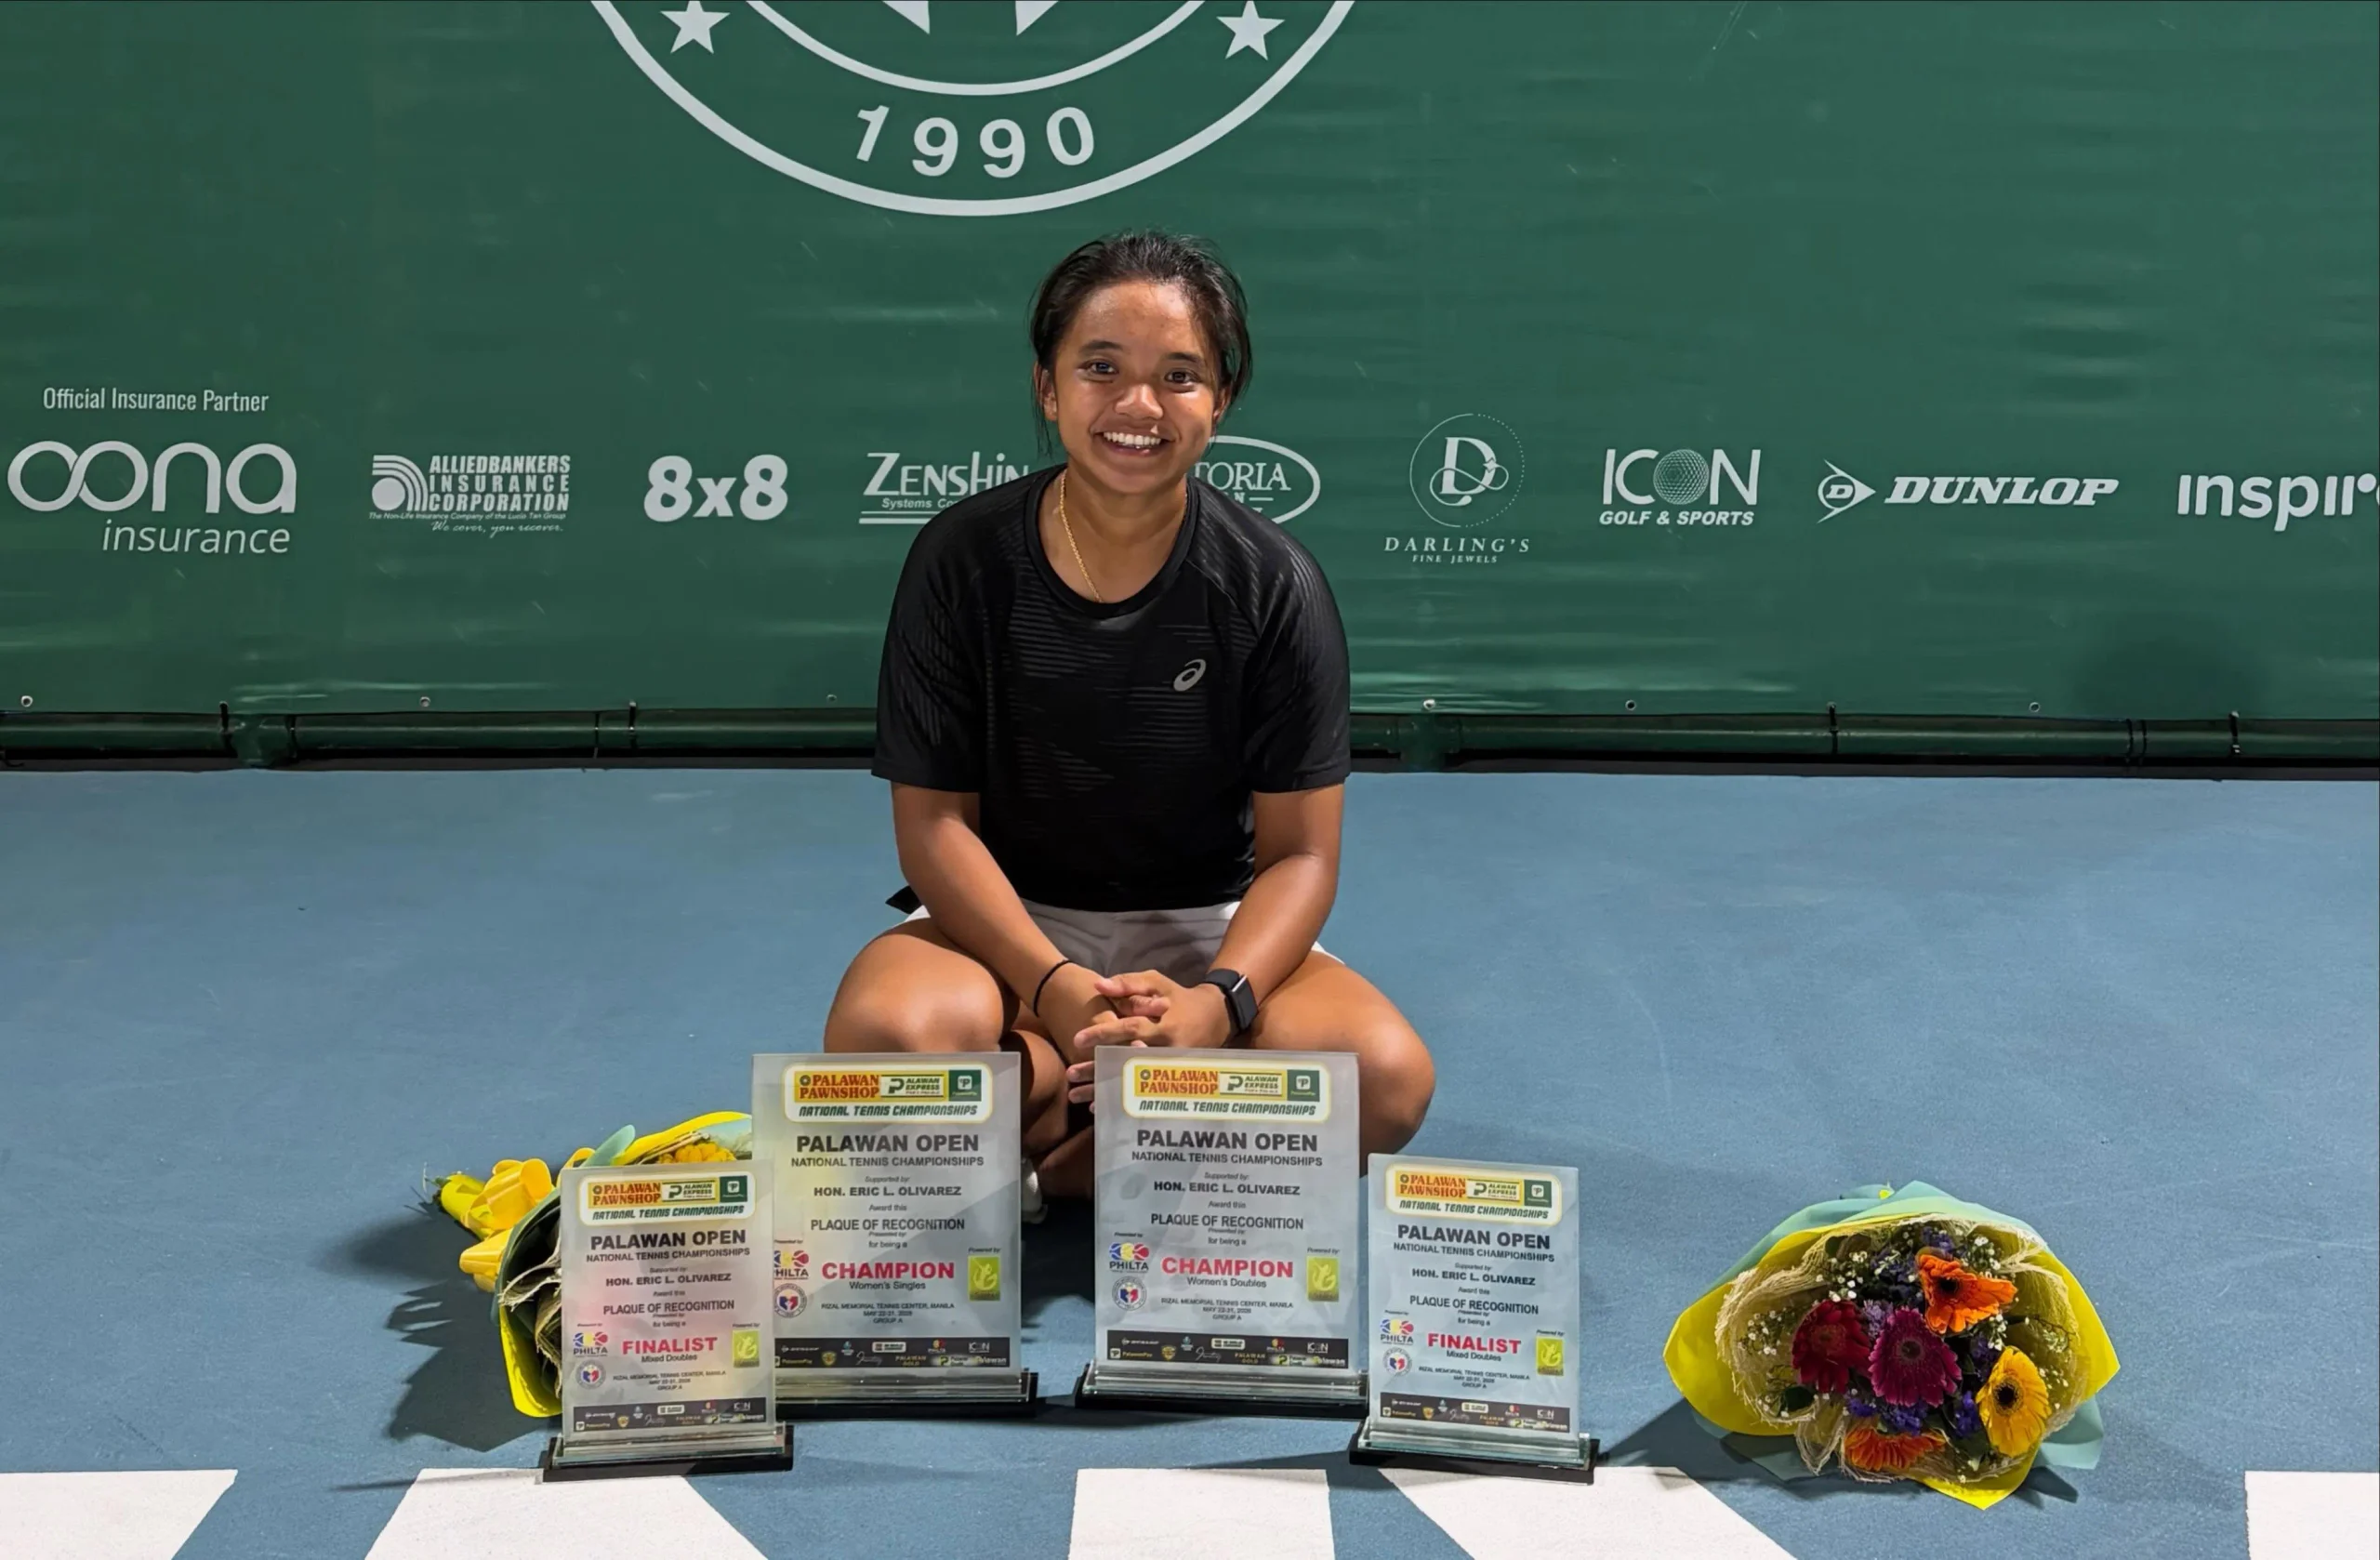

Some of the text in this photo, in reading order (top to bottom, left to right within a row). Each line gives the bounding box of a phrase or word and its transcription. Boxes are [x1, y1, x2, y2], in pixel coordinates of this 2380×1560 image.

[855, 104, 1095, 178] 1990
[44, 388, 270, 412] Official Insurance Partner
[429, 455, 571, 473] ALLIEDBANKERS
[7, 441, 298, 514] oona
[430, 474, 570, 493] INSURANCE
[1194, 462, 1291, 491] TORIA
[643, 455, 788, 522] 8x8
[1884, 475, 2120, 508] DUNLOP
[429, 494, 569, 511] CORPORATION
[881, 497, 932, 510] Systems
[2177, 473, 2378, 532] inspir
[450, 512, 484, 521] Company
[543, 512, 566, 521] Group
[1599, 510, 1754, 527] GOLF & SPORTS
[102, 519, 290, 554] insurance
[431, 521, 450, 532] We
[491, 524, 514, 538] you
[1383, 536, 1529, 553] DARLING'S
[1412, 555, 1498, 564] FINE JEWELS
[812, 1075, 879, 1087] PALAWAN
[1153, 1069, 1219, 1082] PALAWAN
[800, 1087, 879, 1099] PAWNSHOP
[1140, 1081, 1219, 1095] PAWNSHOP
[799, 1104, 977, 1117] NATIONAL TENNIS CHAMPIONSHIPS
[1139, 1100, 1316, 1116] NATIONAL TENNIS CHAMPIONSHIPS
[797, 1134, 979, 1152] PALAWAN OPEN
[1137, 1130, 1317, 1152] PALAWAN OPEN
[791, 1157, 984, 1168] NATIONAL TENNIS CHAMPIONSHIPS
[1131, 1151, 1323, 1167] NATIONAL TENNIS CHAMPIONSHIPS
[1205, 1171, 1238, 1180] Supported
[1410, 1174, 1466, 1186] PALAWAN
[603, 1183, 661, 1195] PALAWAN
[813, 1186, 961, 1196] HON. ERIC L. OLIVAREZ
[1154, 1182, 1301, 1196] HON. ERIC L. OLIVAREZ
[1400, 1184, 1466, 1198] PAWNSHOP
[593, 1193, 661, 1206] PAWNSHOP
[592, 1205, 744, 1221] NATIONAL TENNIS CHAMPIONSHIPS
[1399, 1200, 1549, 1219] NATIONAL TENNIS CHAMPIONSHIPS
[811, 1219, 965, 1232] PLAQUE OF RECOGNITION
[1151, 1213, 1303, 1230] PLAQUE OF RECOGNITION
[591, 1230, 746, 1249] PALAWAN OPEN
[868, 1240, 879, 1249] for
[879, 1240, 901, 1249] being
[1209, 1236, 1218, 1245] for
[1219, 1237, 1239, 1247] being
[1398, 1224, 1550, 1249] PALAWAN OPEN
[587, 1248, 750, 1263] NATIONAL TENNIS CHAMPIONSHIPS
[1394, 1242, 1554, 1263] NATIONAL TENNIS CHAMPIONSHIPS
[822, 1263, 955, 1279] CHAMPION
[1109, 1261, 1149, 1272] PHILTA
[1162, 1257, 1293, 1277] CHAMPION
[606, 1274, 732, 1287] HON. ERIC L. OLIVAREZ
[1187, 1276, 1266, 1289] Women's Doubles
[1412, 1268, 1536, 1286] HON. ERIC L. OLIVAREZ
[849, 1281, 926, 1290] Women's Singles
[603, 1301, 734, 1315] PLAQUE OF RECOGNITION
[1409, 1295, 1539, 1315] PLAQUE OF RECOGNITION
[622, 1337, 718, 1355] FINALIST
[1381, 1334, 1414, 1343] PHILTA
[1427, 1333, 1522, 1354] FINALIST
[574, 1346, 608, 1355] PHILTA
[641, 1354, 697, 1363] Mixed Doubles
[1447, 1350, 1501, 1362] Mixed Doubles
